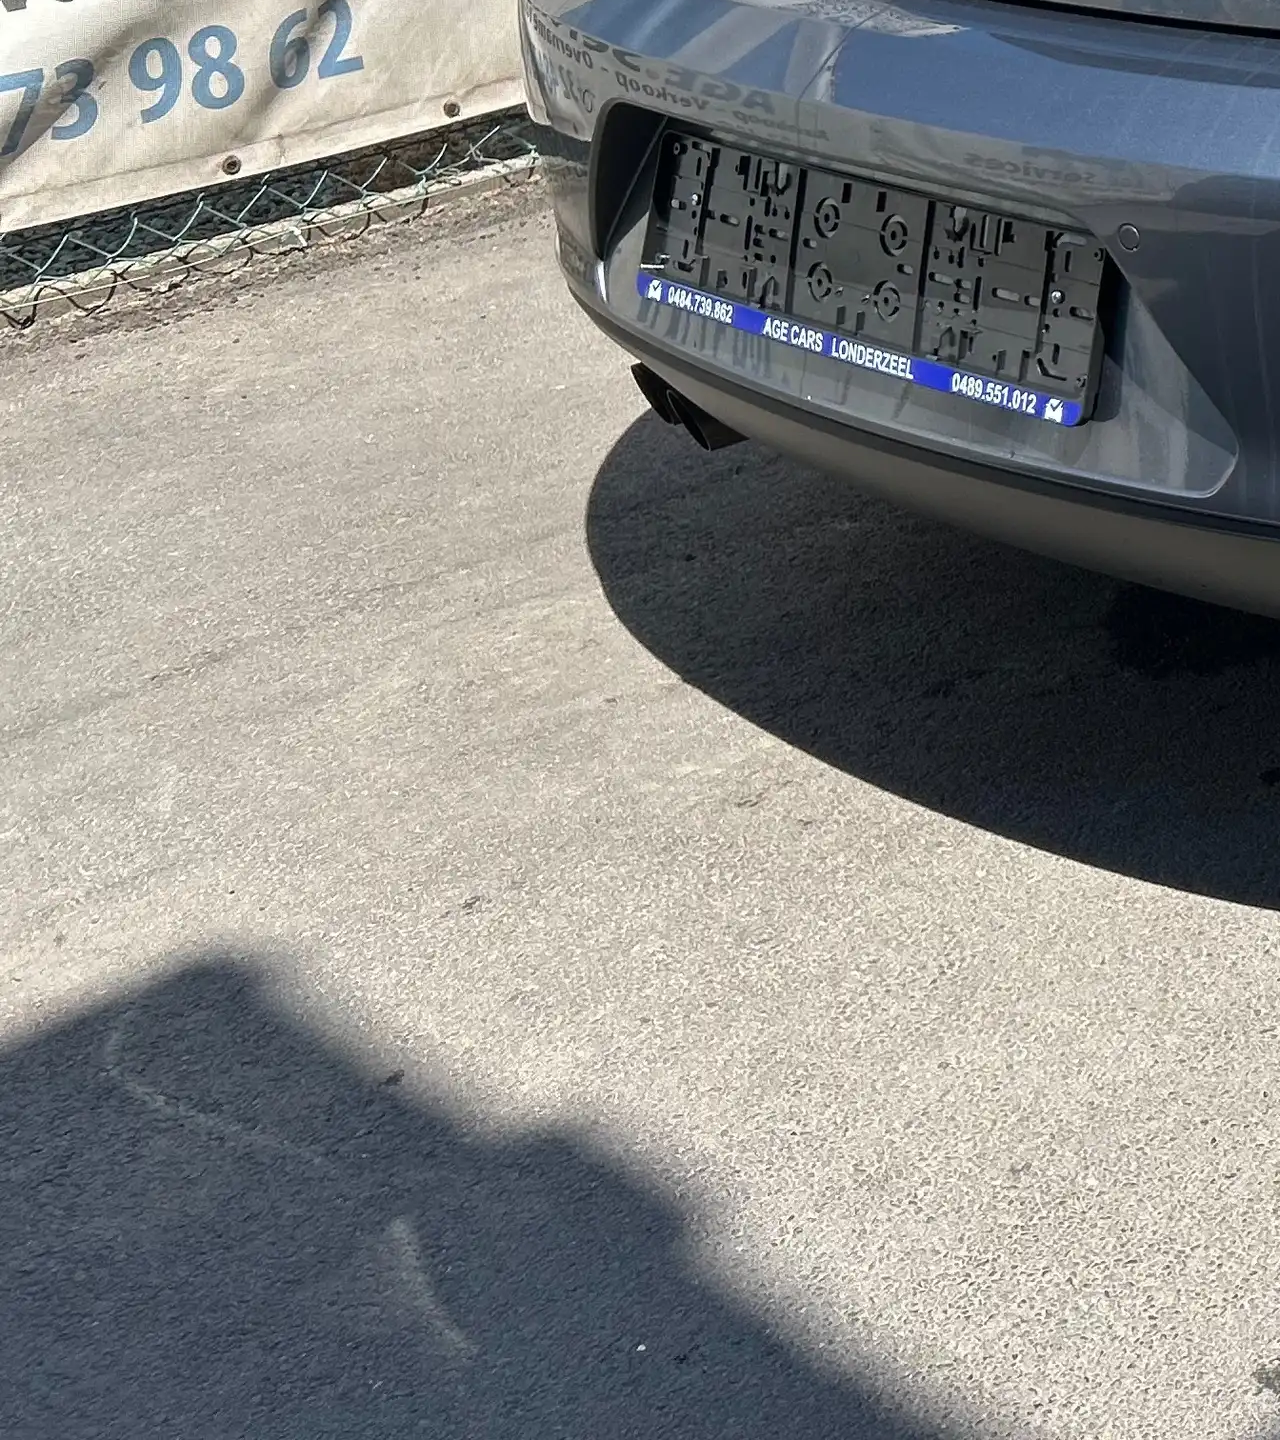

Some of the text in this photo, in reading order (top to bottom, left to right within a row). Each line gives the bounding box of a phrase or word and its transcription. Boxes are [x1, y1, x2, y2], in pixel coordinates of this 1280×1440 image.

[0, 58, 99, 158] 73
[128, 25, 246, 124] 98
[667, 285, 1037, 414] 0484.739.862 AGE CARS LONDERZEEL 0489.551.012
